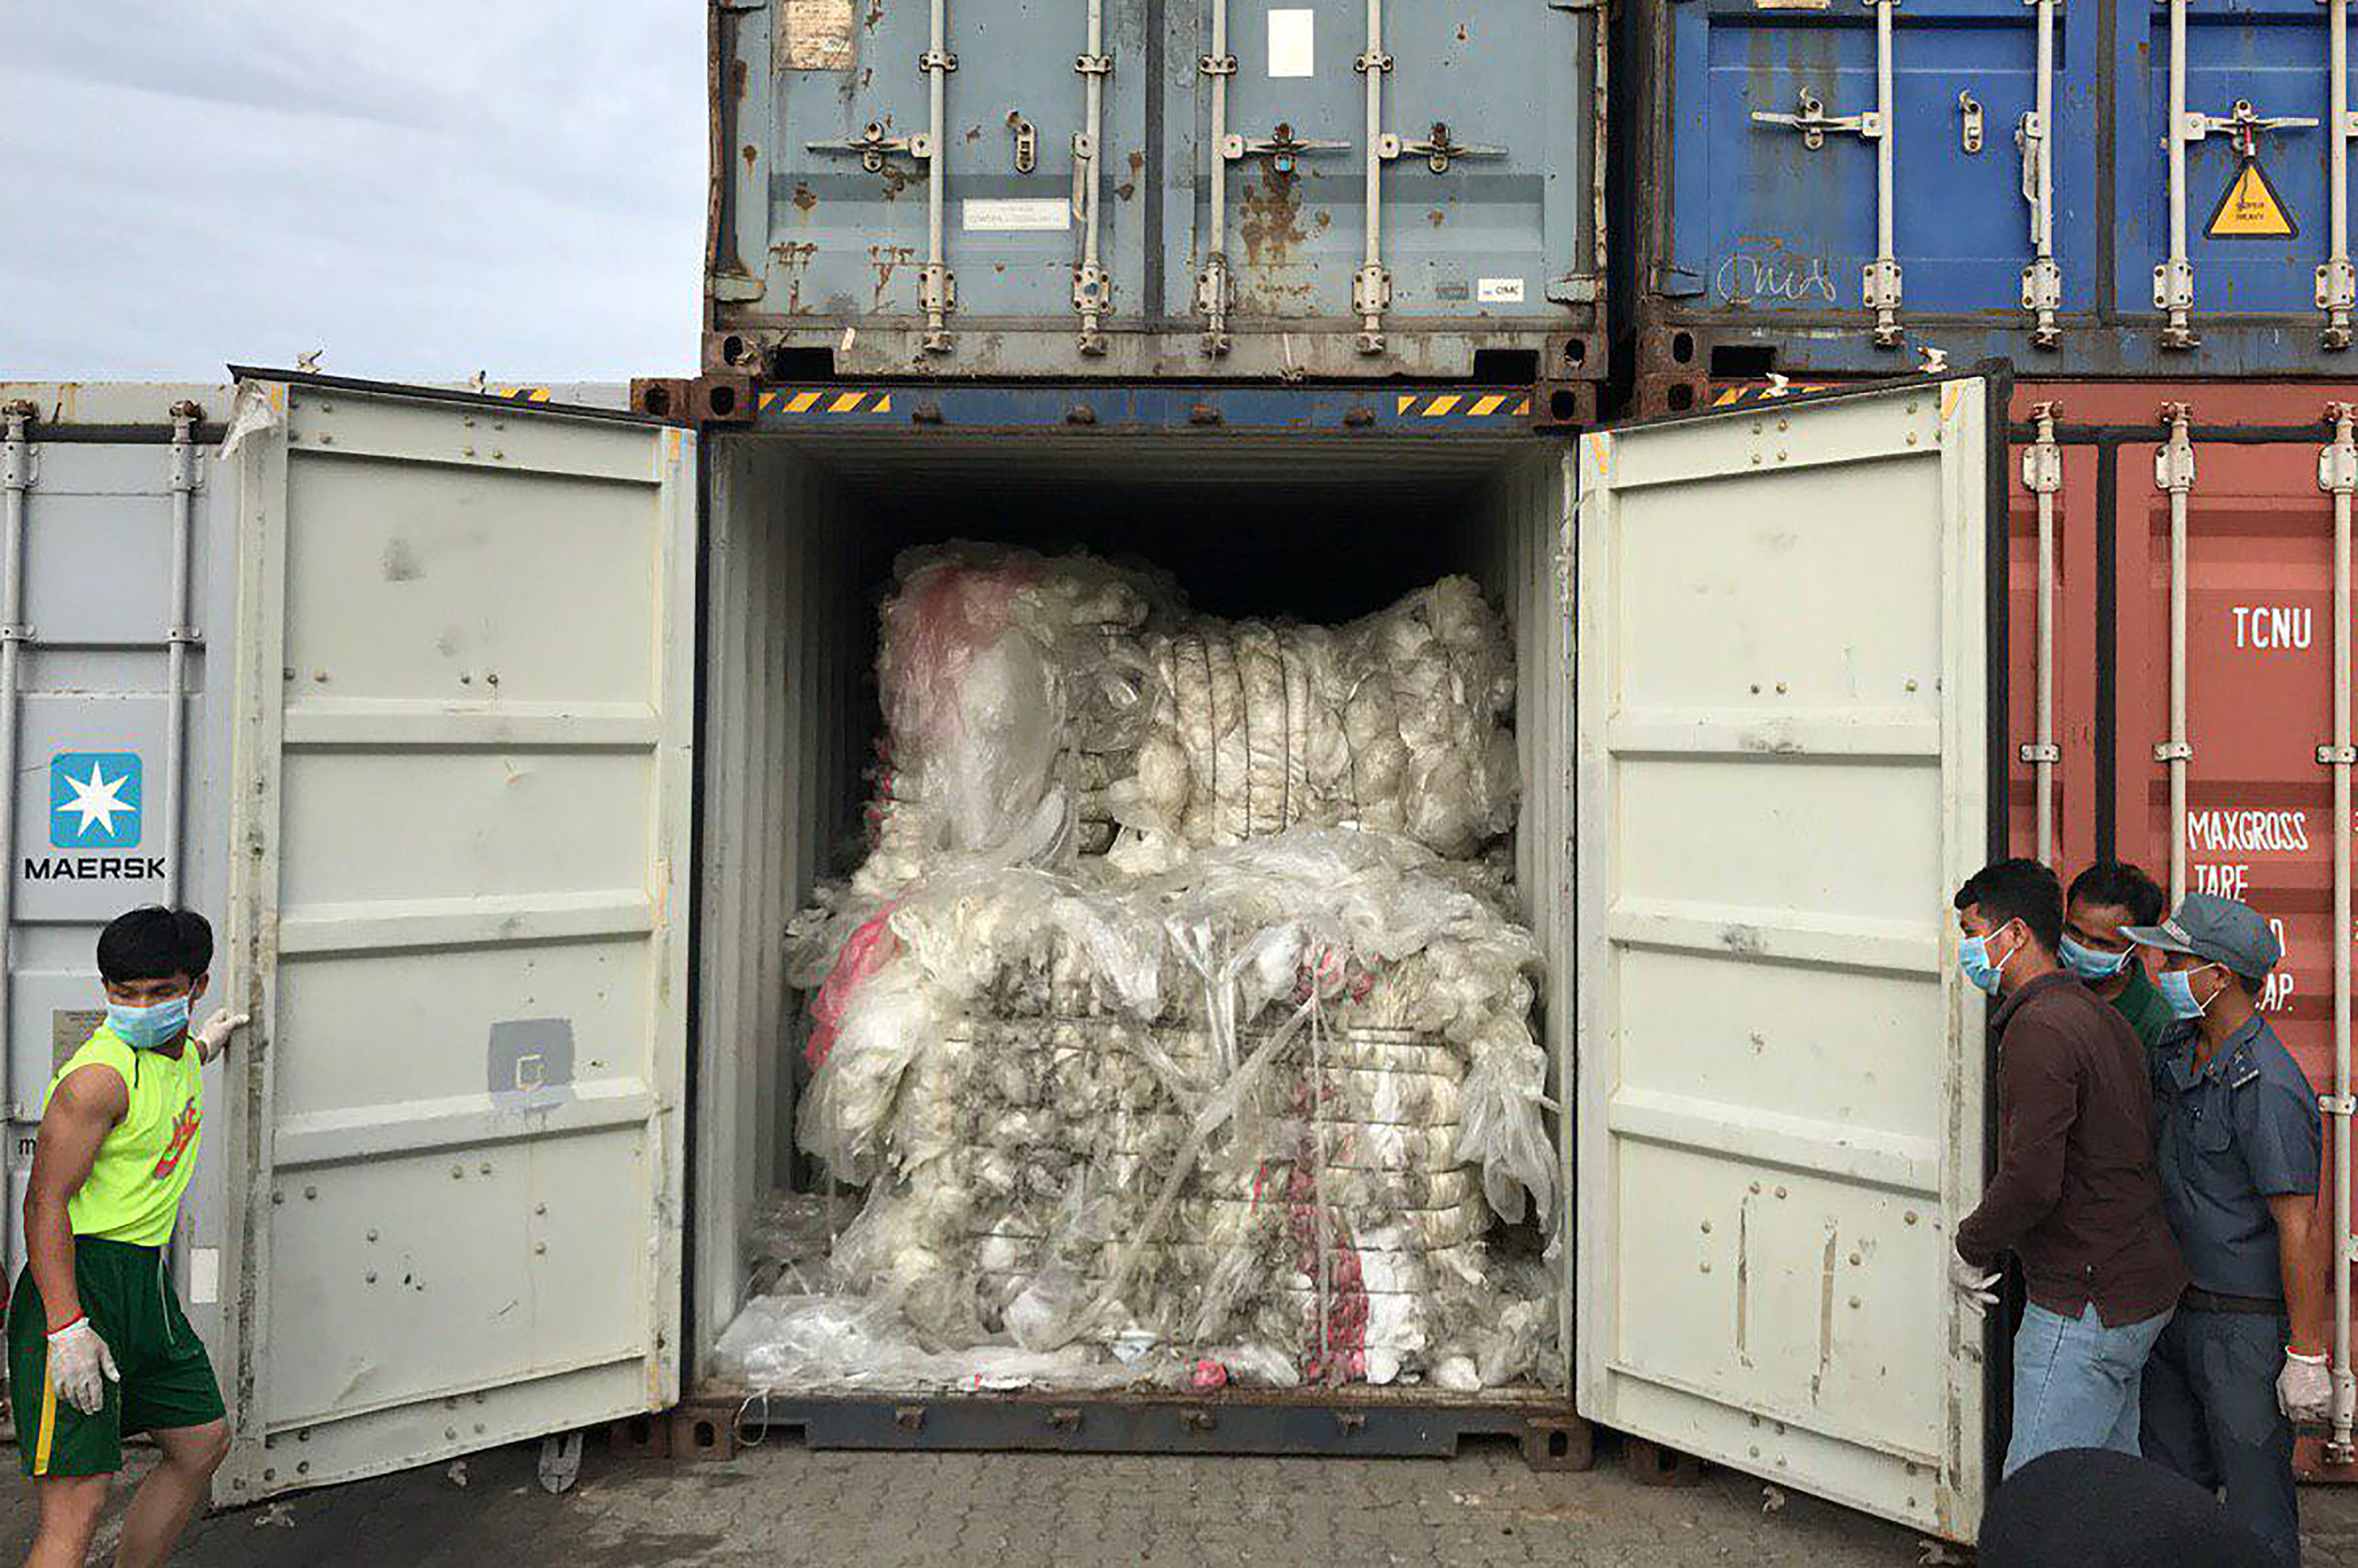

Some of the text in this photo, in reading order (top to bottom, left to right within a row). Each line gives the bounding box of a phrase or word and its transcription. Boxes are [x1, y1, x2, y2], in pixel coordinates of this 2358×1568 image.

[2232, 607, 2312, 648] TCNU
[2187, 811, 2308, 851] MAXGROSS
[24, 857, 166, 879] MAERSK
[2195, 865, 2249, 903] TARE
